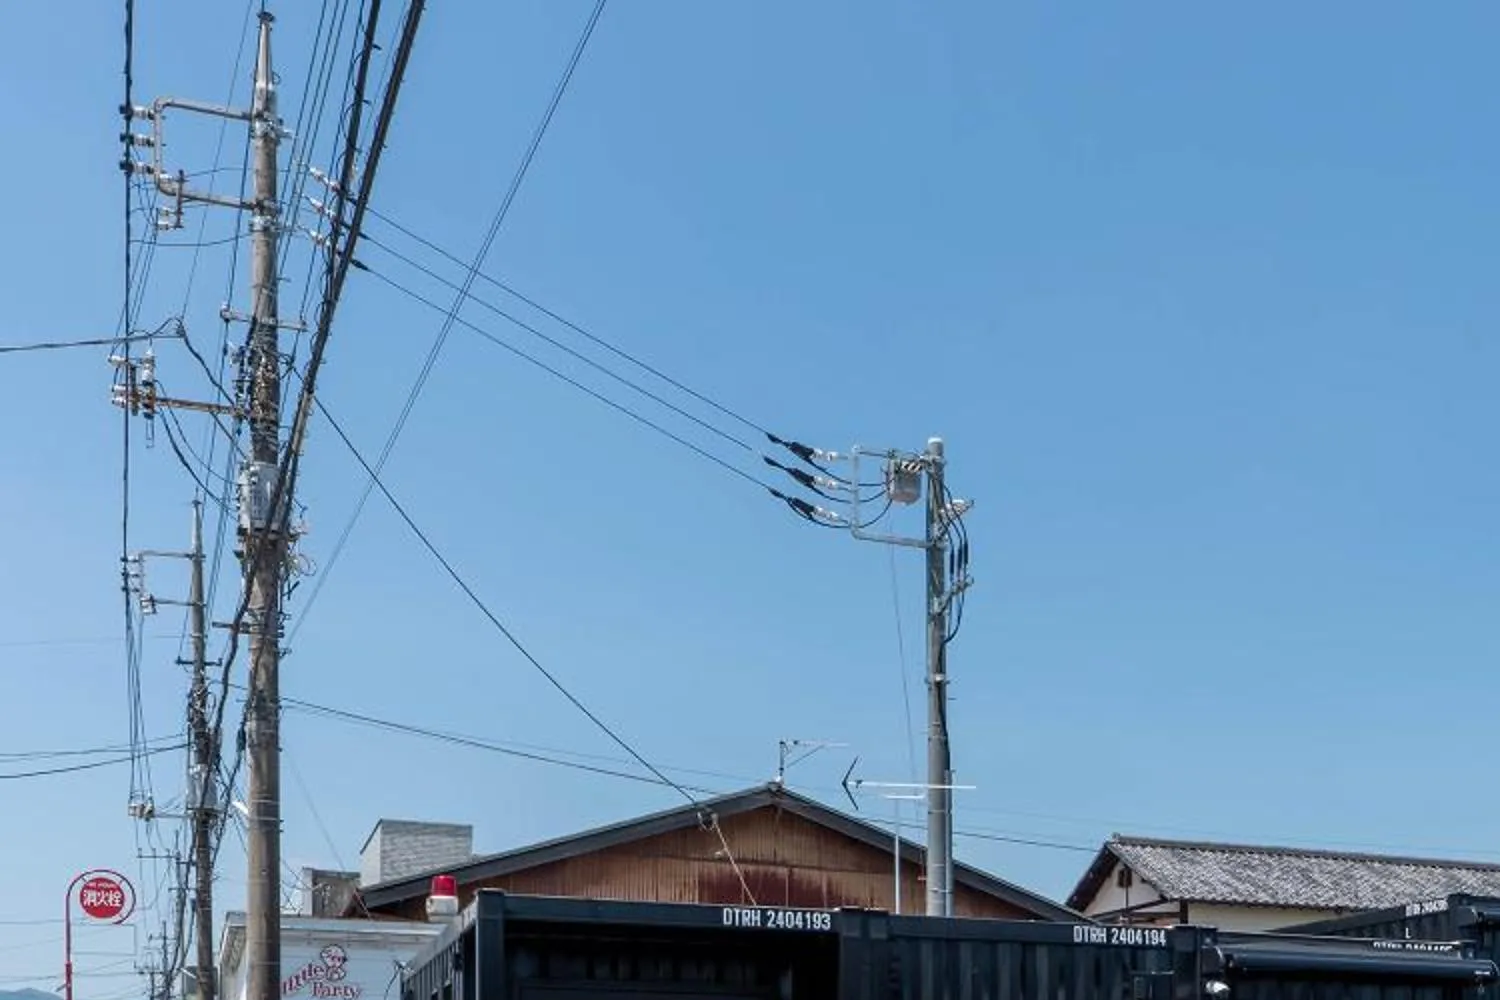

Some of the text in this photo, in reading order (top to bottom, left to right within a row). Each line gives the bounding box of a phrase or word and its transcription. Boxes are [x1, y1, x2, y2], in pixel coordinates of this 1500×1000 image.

[723, 907, 831, 931] DTRH 2404193
[1073, 926, 1167, 947] DTRH 2404194
